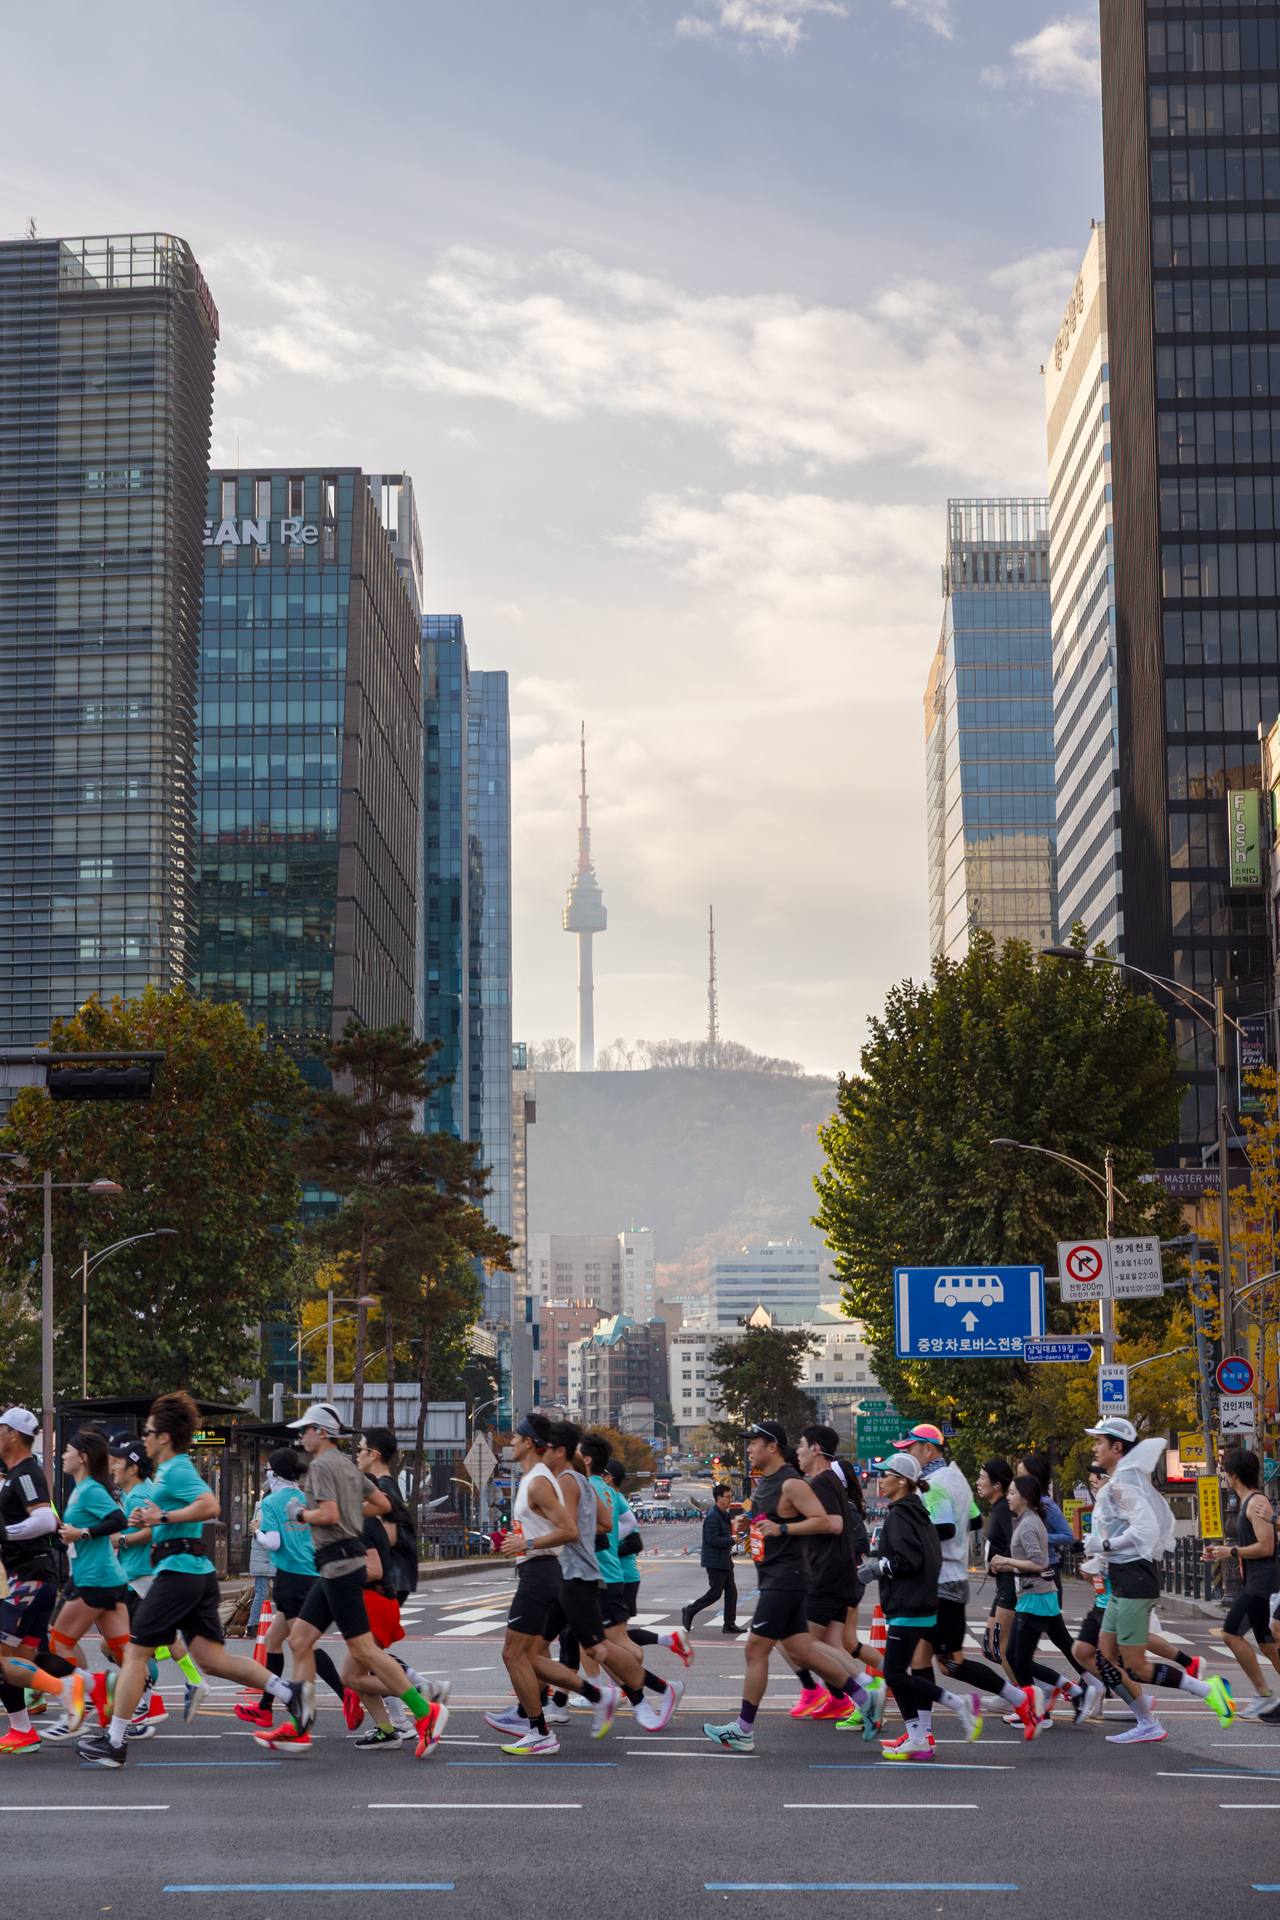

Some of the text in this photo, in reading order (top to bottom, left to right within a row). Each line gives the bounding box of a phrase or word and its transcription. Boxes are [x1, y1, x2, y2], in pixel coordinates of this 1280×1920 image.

[281, 520, 319, 545] Re
[1234, 795, 1248, 863] Fresh
[1234, 867, 1256, 875] 스터디
[1164, 1174, 1202, 1184] MASTER
[1204, 1173, 1222, 1183] MIN
[1115, 1242, 1154, 1254] 청계천로
[1027, 1344, 1074, 1354] 삼일대로19길
[1222, 1401, 1253, 1411] 견인지역
